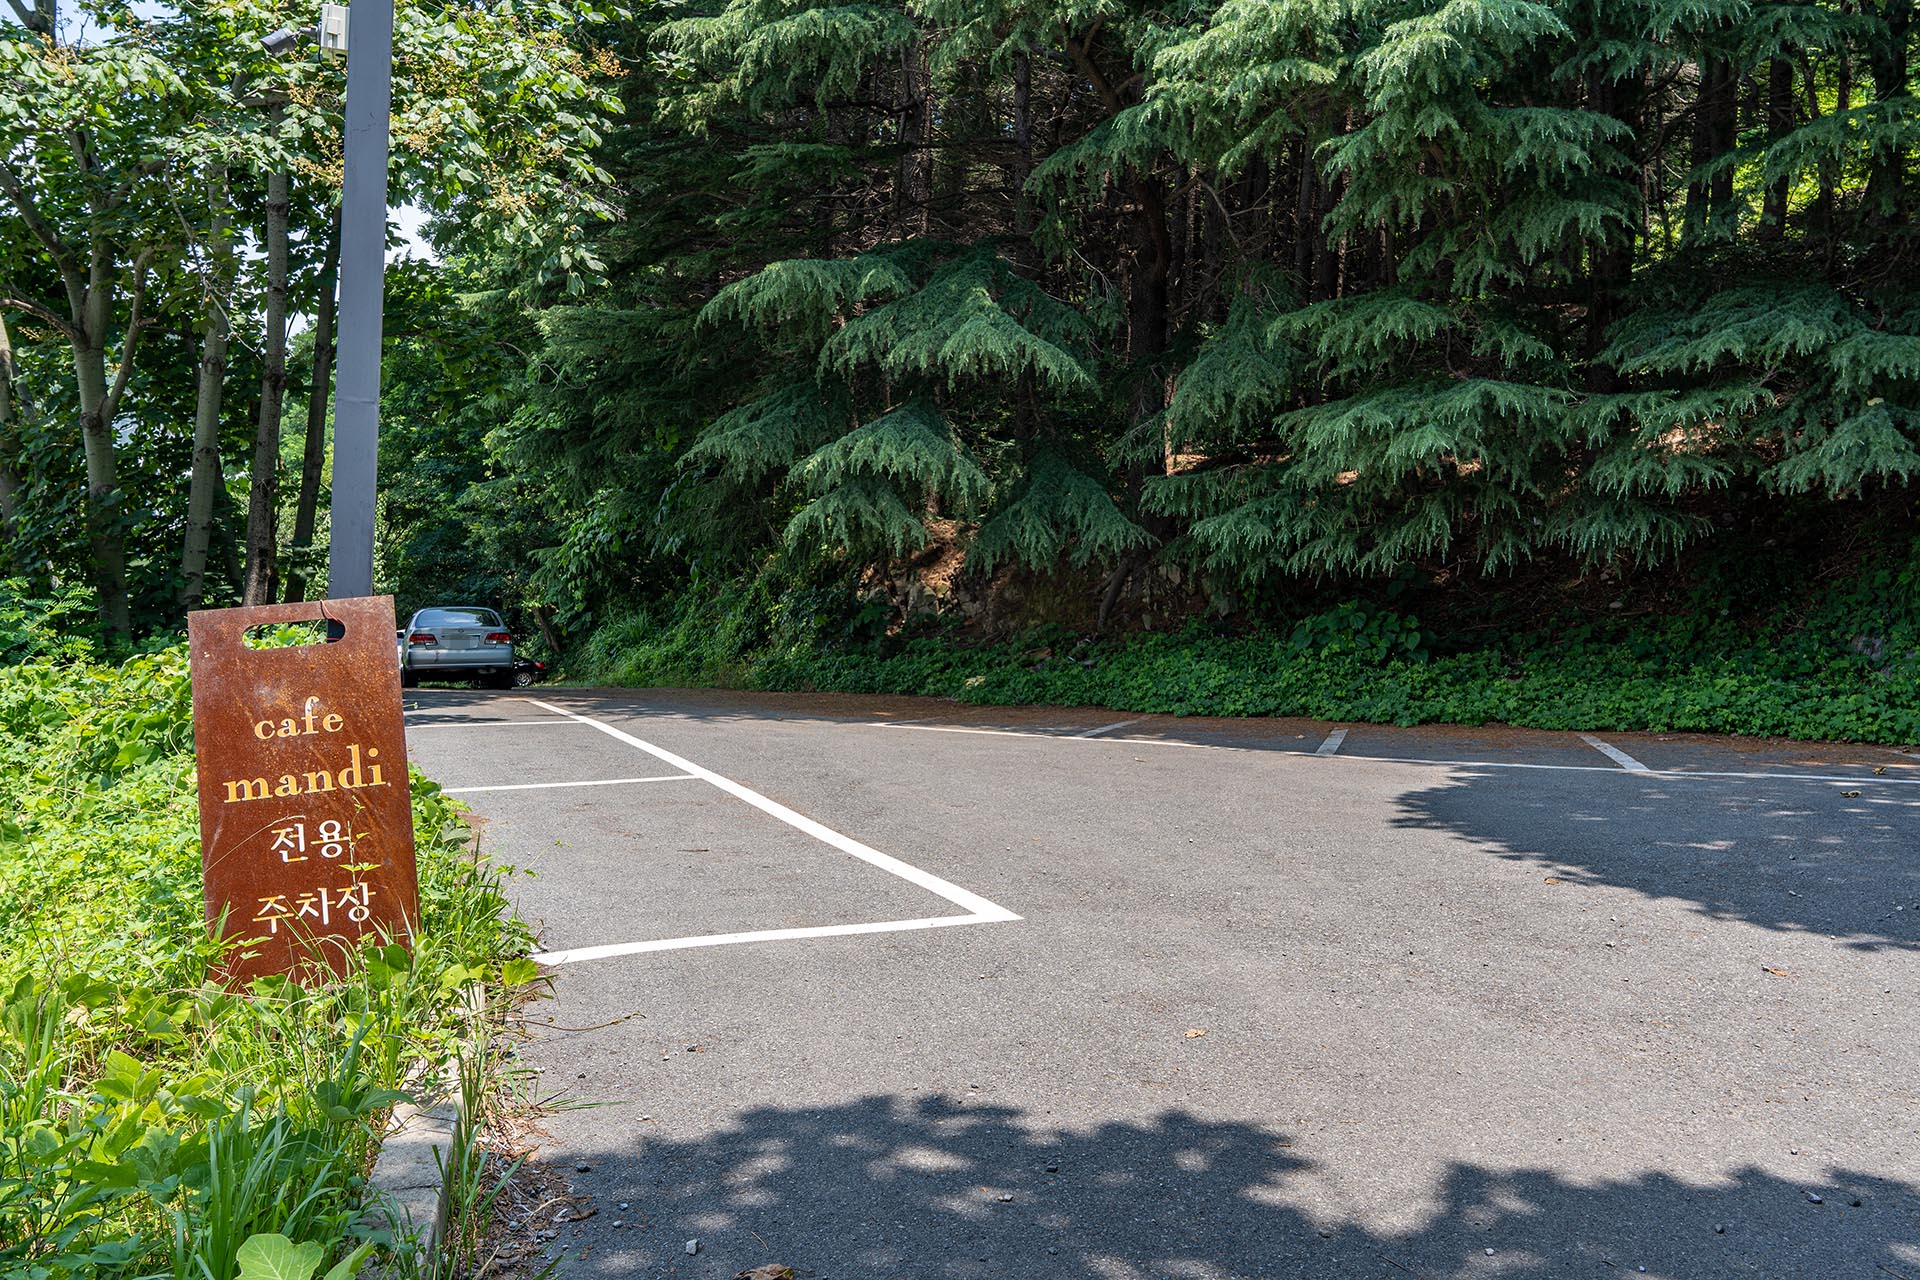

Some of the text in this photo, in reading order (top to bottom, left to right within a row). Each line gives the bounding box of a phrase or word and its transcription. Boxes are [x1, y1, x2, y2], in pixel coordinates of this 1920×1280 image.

[254, 695, 344, 741] cafe
[222, 743, 387, 804] mandi
[270, 819, 352, 864] 전용
[252, 882, 377, 934] 주차장
